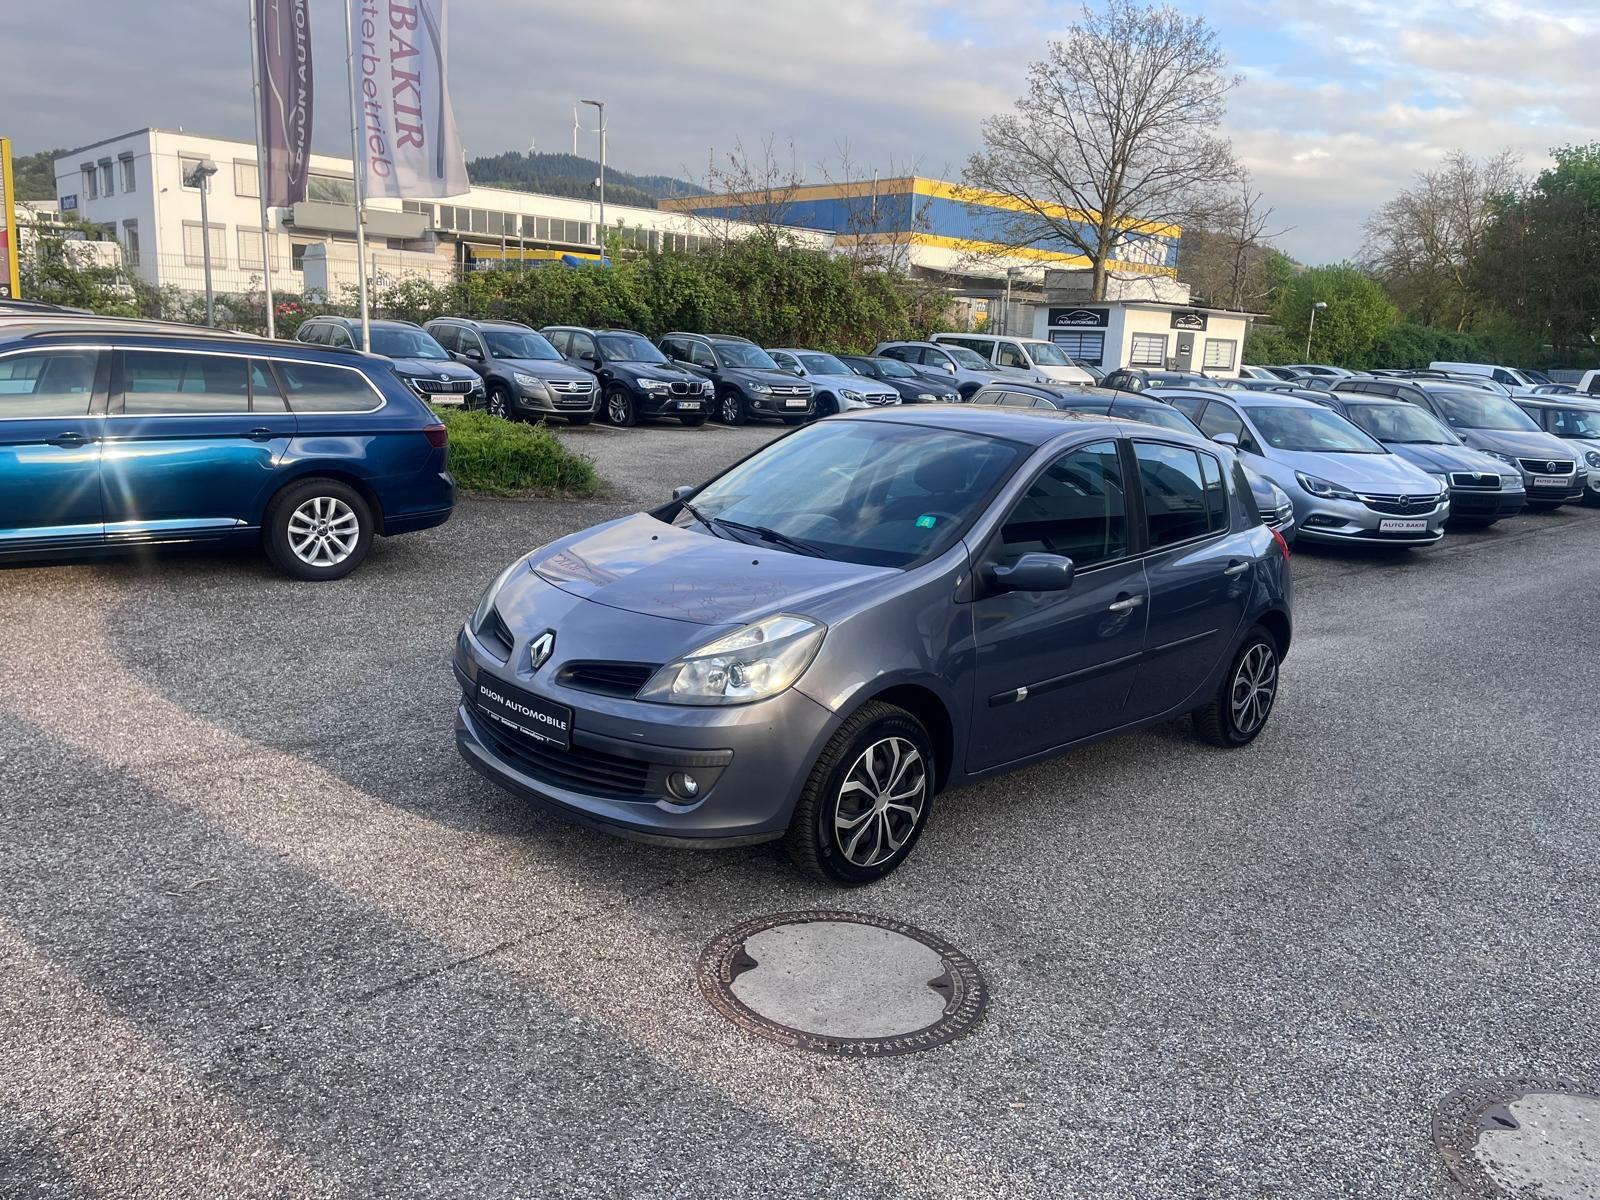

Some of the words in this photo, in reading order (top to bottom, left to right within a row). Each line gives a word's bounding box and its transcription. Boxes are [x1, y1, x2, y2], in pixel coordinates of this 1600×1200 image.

[295, 88, 307, 165] DIJON
[361, 0, 393, 178] terbetrieb
[388, 0, 425, 150] BAKIR
[480, 686, 504, 703] DIJON
[505, 699, 567, 730] AUTOMOBILE
